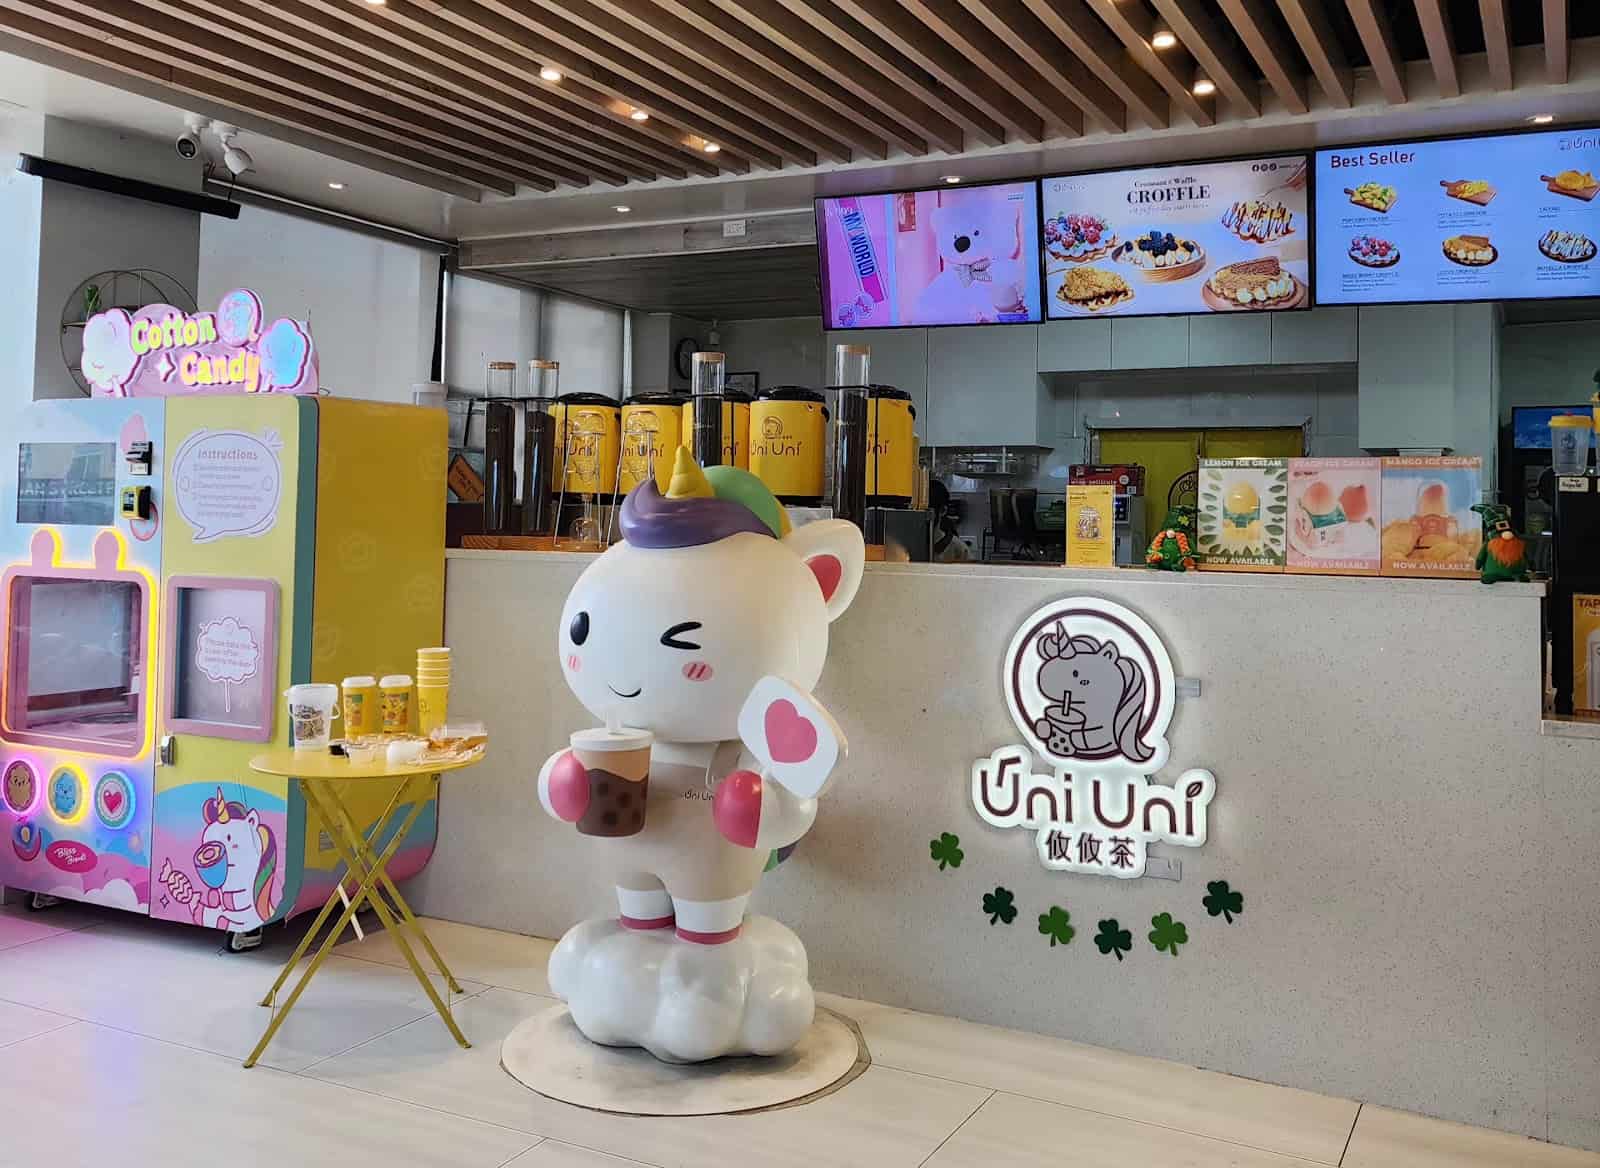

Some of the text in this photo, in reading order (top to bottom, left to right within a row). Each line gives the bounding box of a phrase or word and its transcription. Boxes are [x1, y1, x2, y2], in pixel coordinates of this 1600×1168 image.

[1331, 151, 1416, 168] Best Seller
[1127, 185, 1211, 204] CROFFLE
[850, 231, 876, 278] WORLD
[131, 312, 217, 355] Cotton
[181, 349, 261, 393] Candy
[772, 440, 802, 457] Uni
[1204, 459, 1282, 467] LEMON ICE CREAM
[1393, 561, 1416, 569] NOW
[980, 756, 1204, 836] Uni Uni
